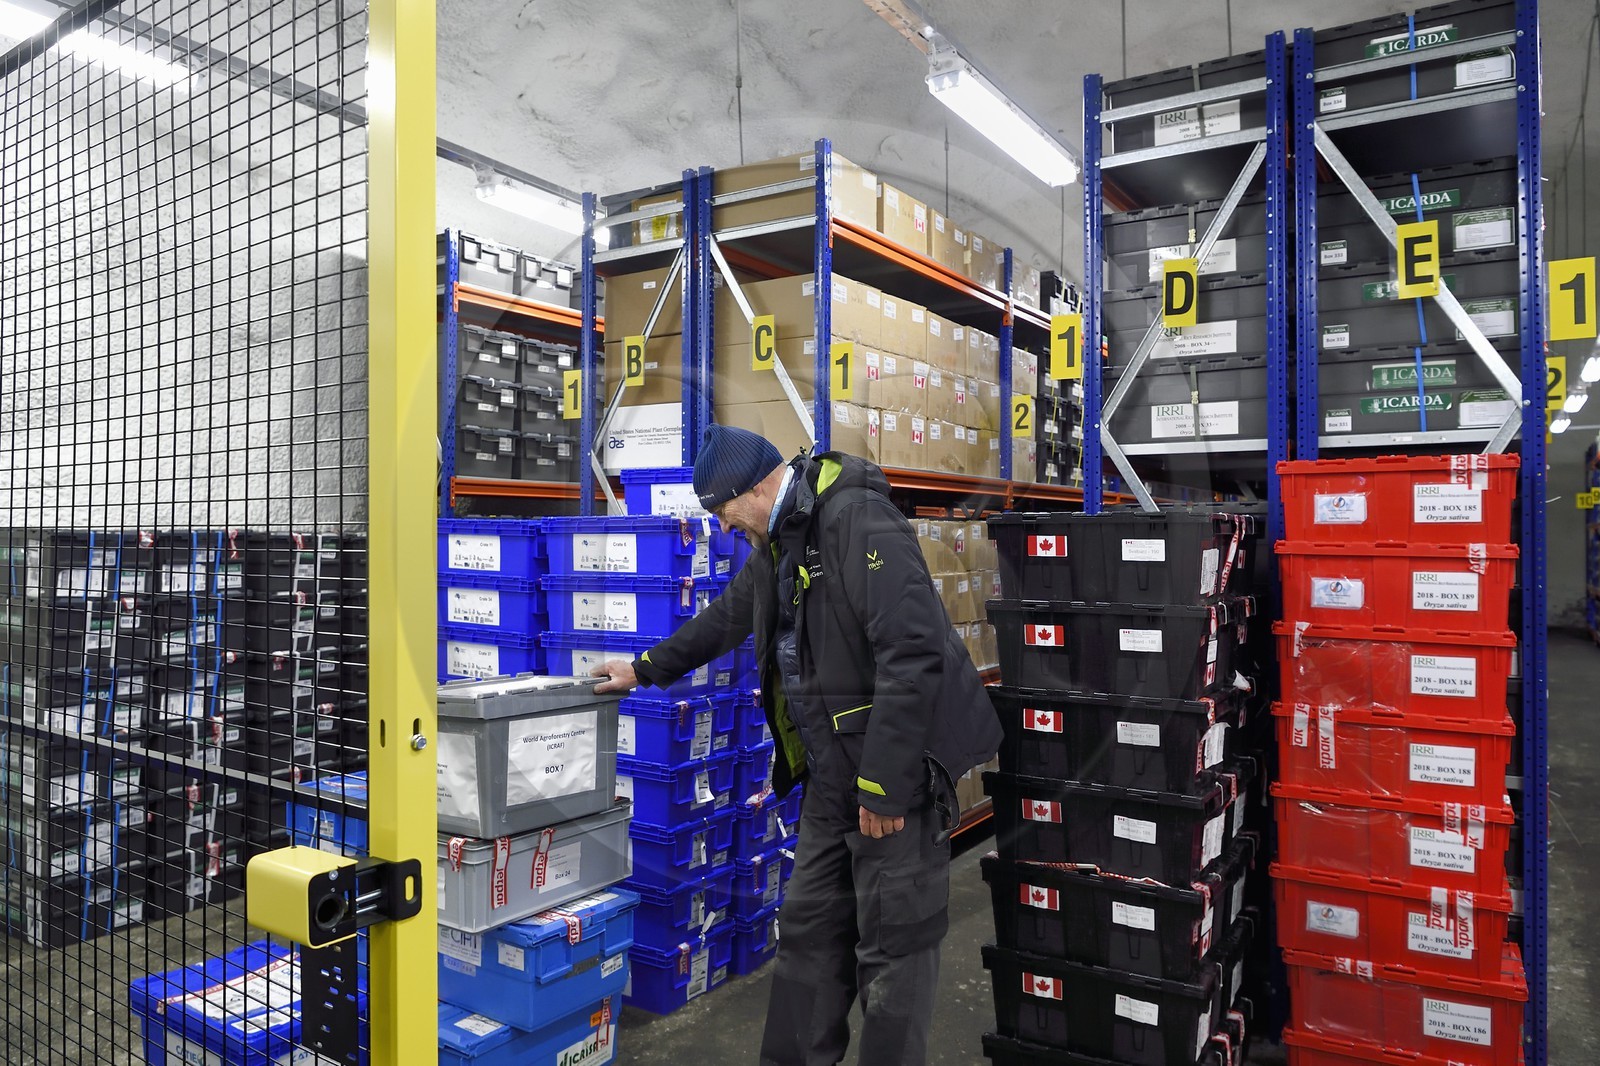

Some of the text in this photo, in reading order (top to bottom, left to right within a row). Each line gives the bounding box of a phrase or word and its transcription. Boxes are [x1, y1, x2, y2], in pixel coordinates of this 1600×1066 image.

[1160, 110, 1186, 125] IRRI
[1404, 234, 1434, 286] E
[1165, 271, 1194, 316] D
[1560, 272, 1587, 325] 1
[754, 324, 773, 362] C
[1057, 326, 1076, 368] 1
[627, 344, 642, 378] B
[835, 352, 850, 390] 1
[1393, 367, 1452, 380] ICARDA
[1547, 368, 1563, 400] 2
[568, 378, 578, 410] 1
[1383, 394, 1444, 408] ICARDA
[1014, 402, 1030, 430] 2
[1156, 405, 1184, 416] IRRI
[1417, 486, 1440, 494] IRRI
[1414, 657, 1436, 665] IRRI
[523, 736, 539, 744] World
[540, 732, 570, 742] Agroforestry
[547, 742, 565, 751] (ICRAF)
[1412, 745, 1434, 754] IRRI
[545, 765, 559, 774] BOX
[1413, 828, 1435, 838] IRRI
[1438, 851, 1456, 859] BOX
[1420, 858, 1464, 869] Oryza sativa
[1411, 933, 1428, 941] 2018
[1436, 936, 1453, 946] BOX
[1418, 943, 1438, 952] Oryza
[1426, 1000, 1449, 1011] IRRI
[1428, 1020, 1446, 1028] 2018
[1452, 1024, 1471, 1032] BOX
[1435, 1030, 1479, 1042] Oryza sativa
